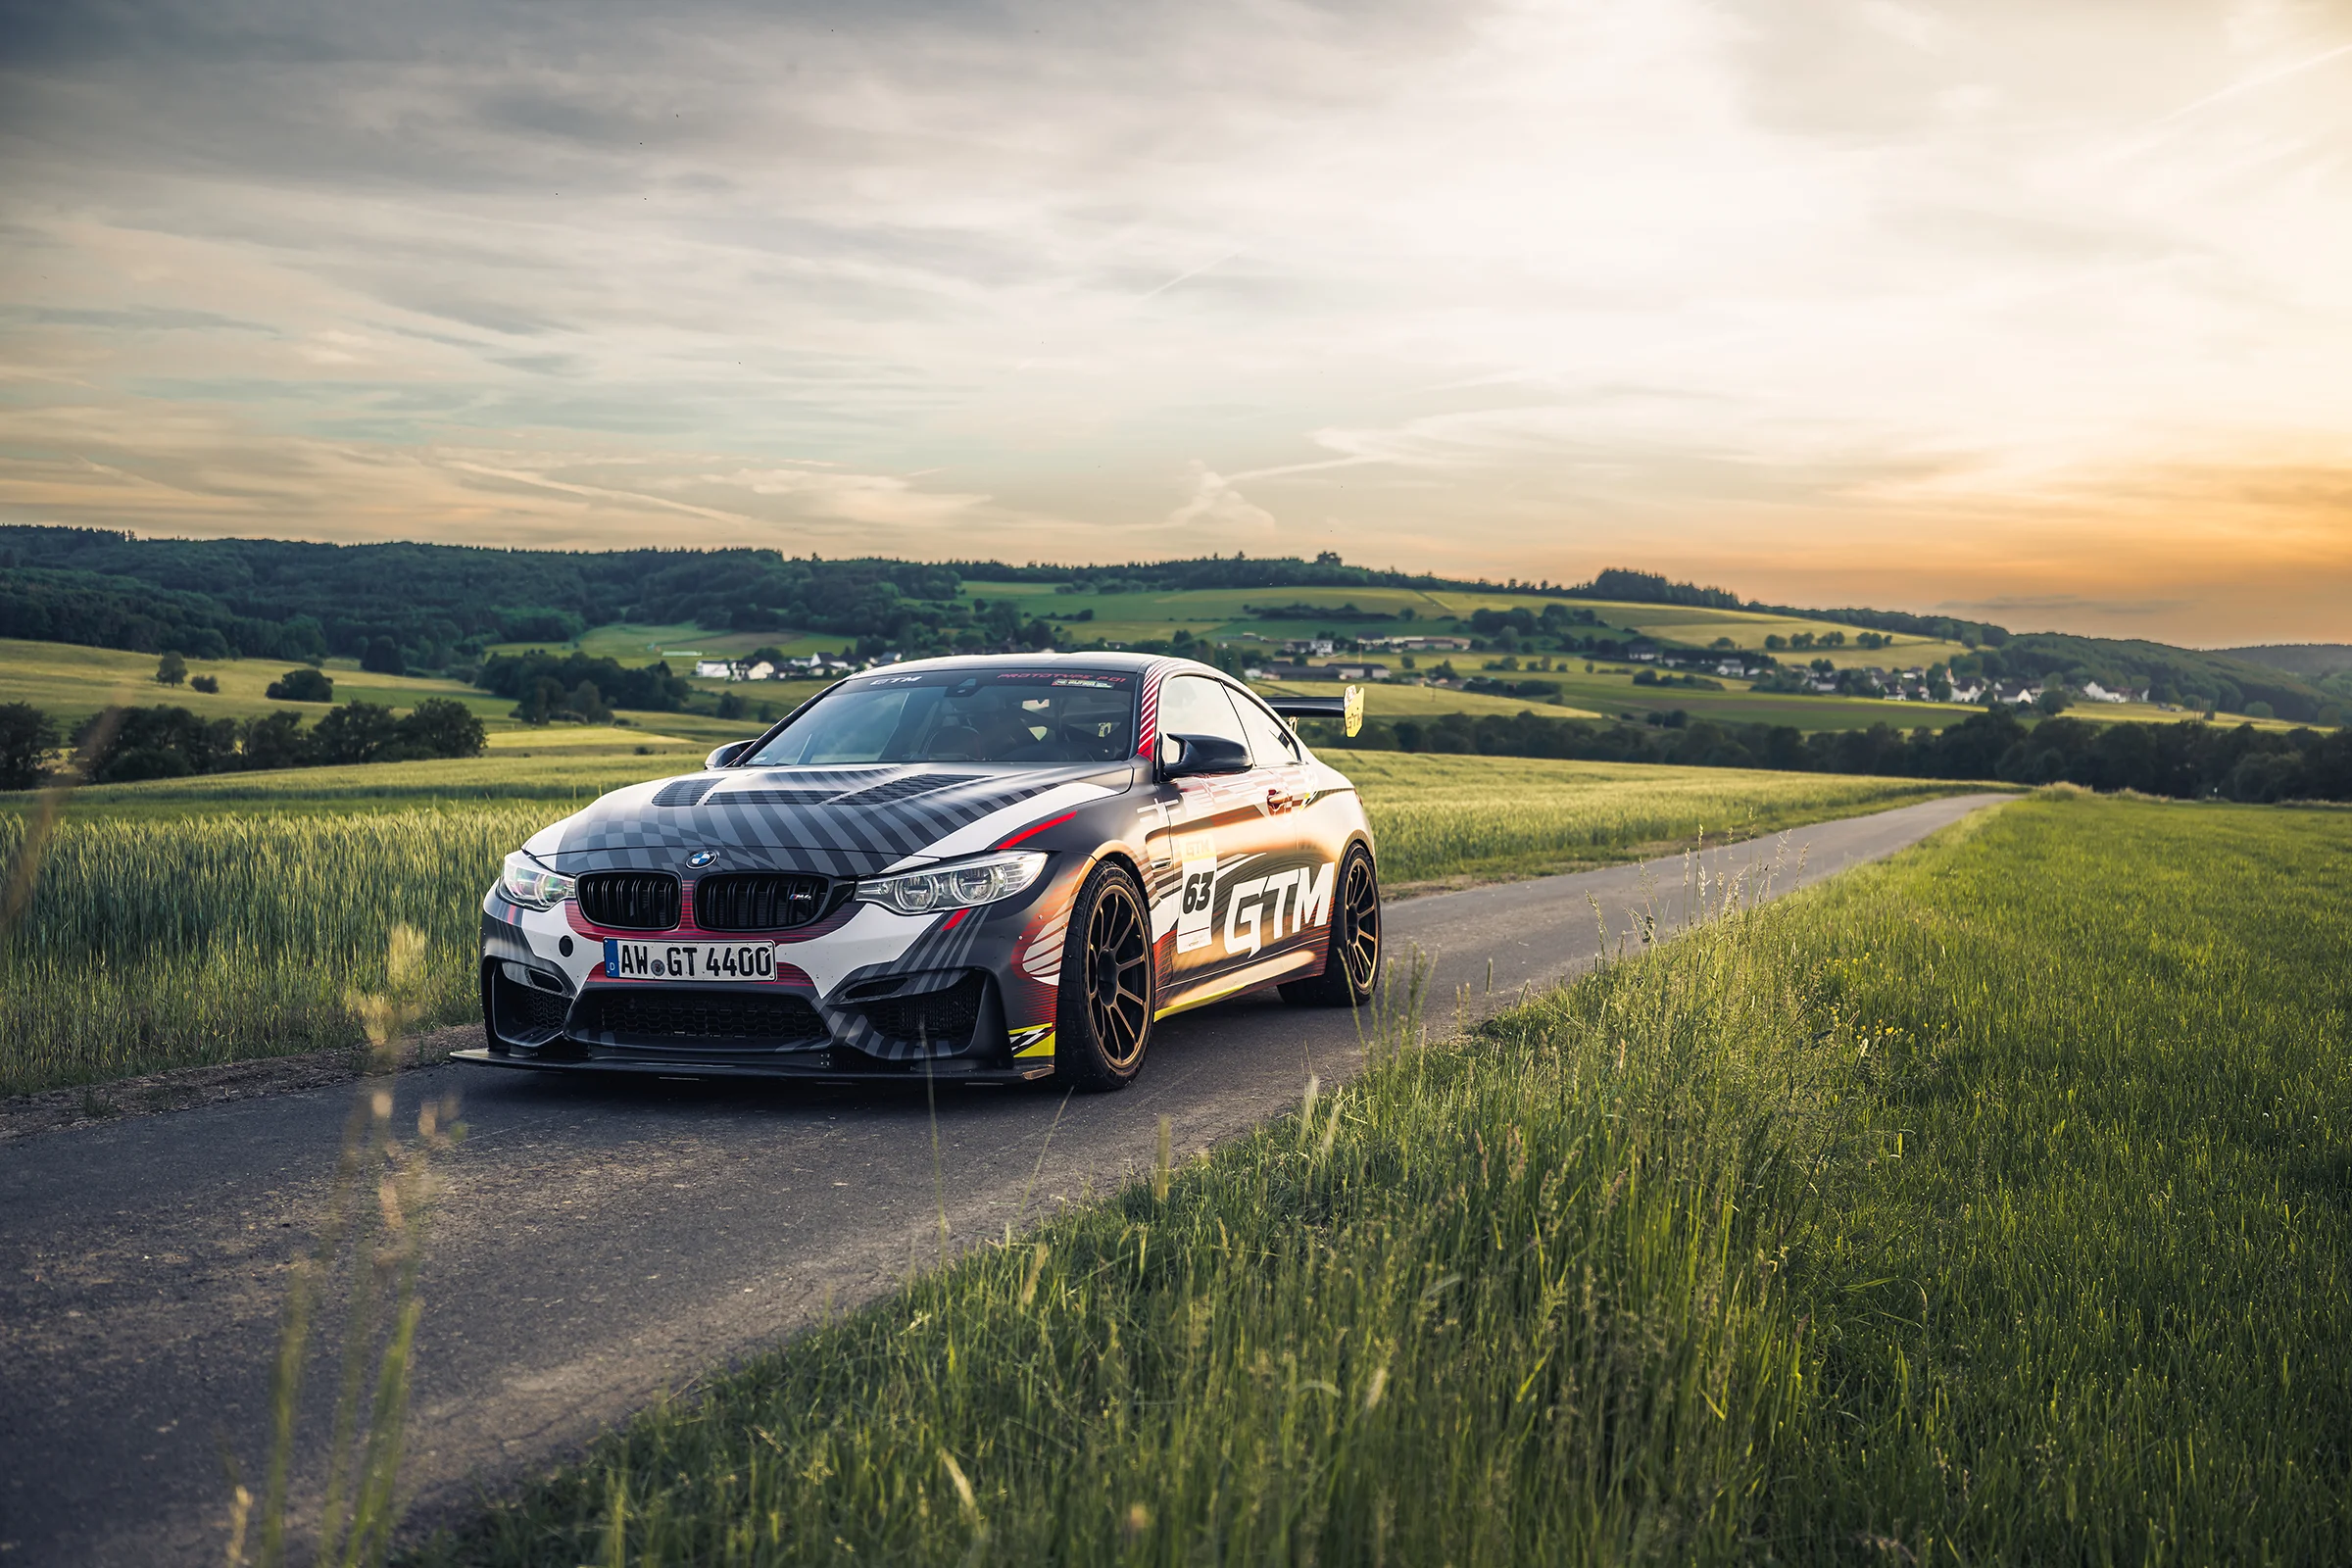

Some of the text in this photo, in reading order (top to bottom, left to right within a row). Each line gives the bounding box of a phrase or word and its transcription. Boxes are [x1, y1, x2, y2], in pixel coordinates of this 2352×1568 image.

[1182, 870, 1215, 915] 63
[1224, 861, 1336, 959] GTM
[609, 961, 615, 971] D
[620, 945, 772, 977] AW GT 4400
